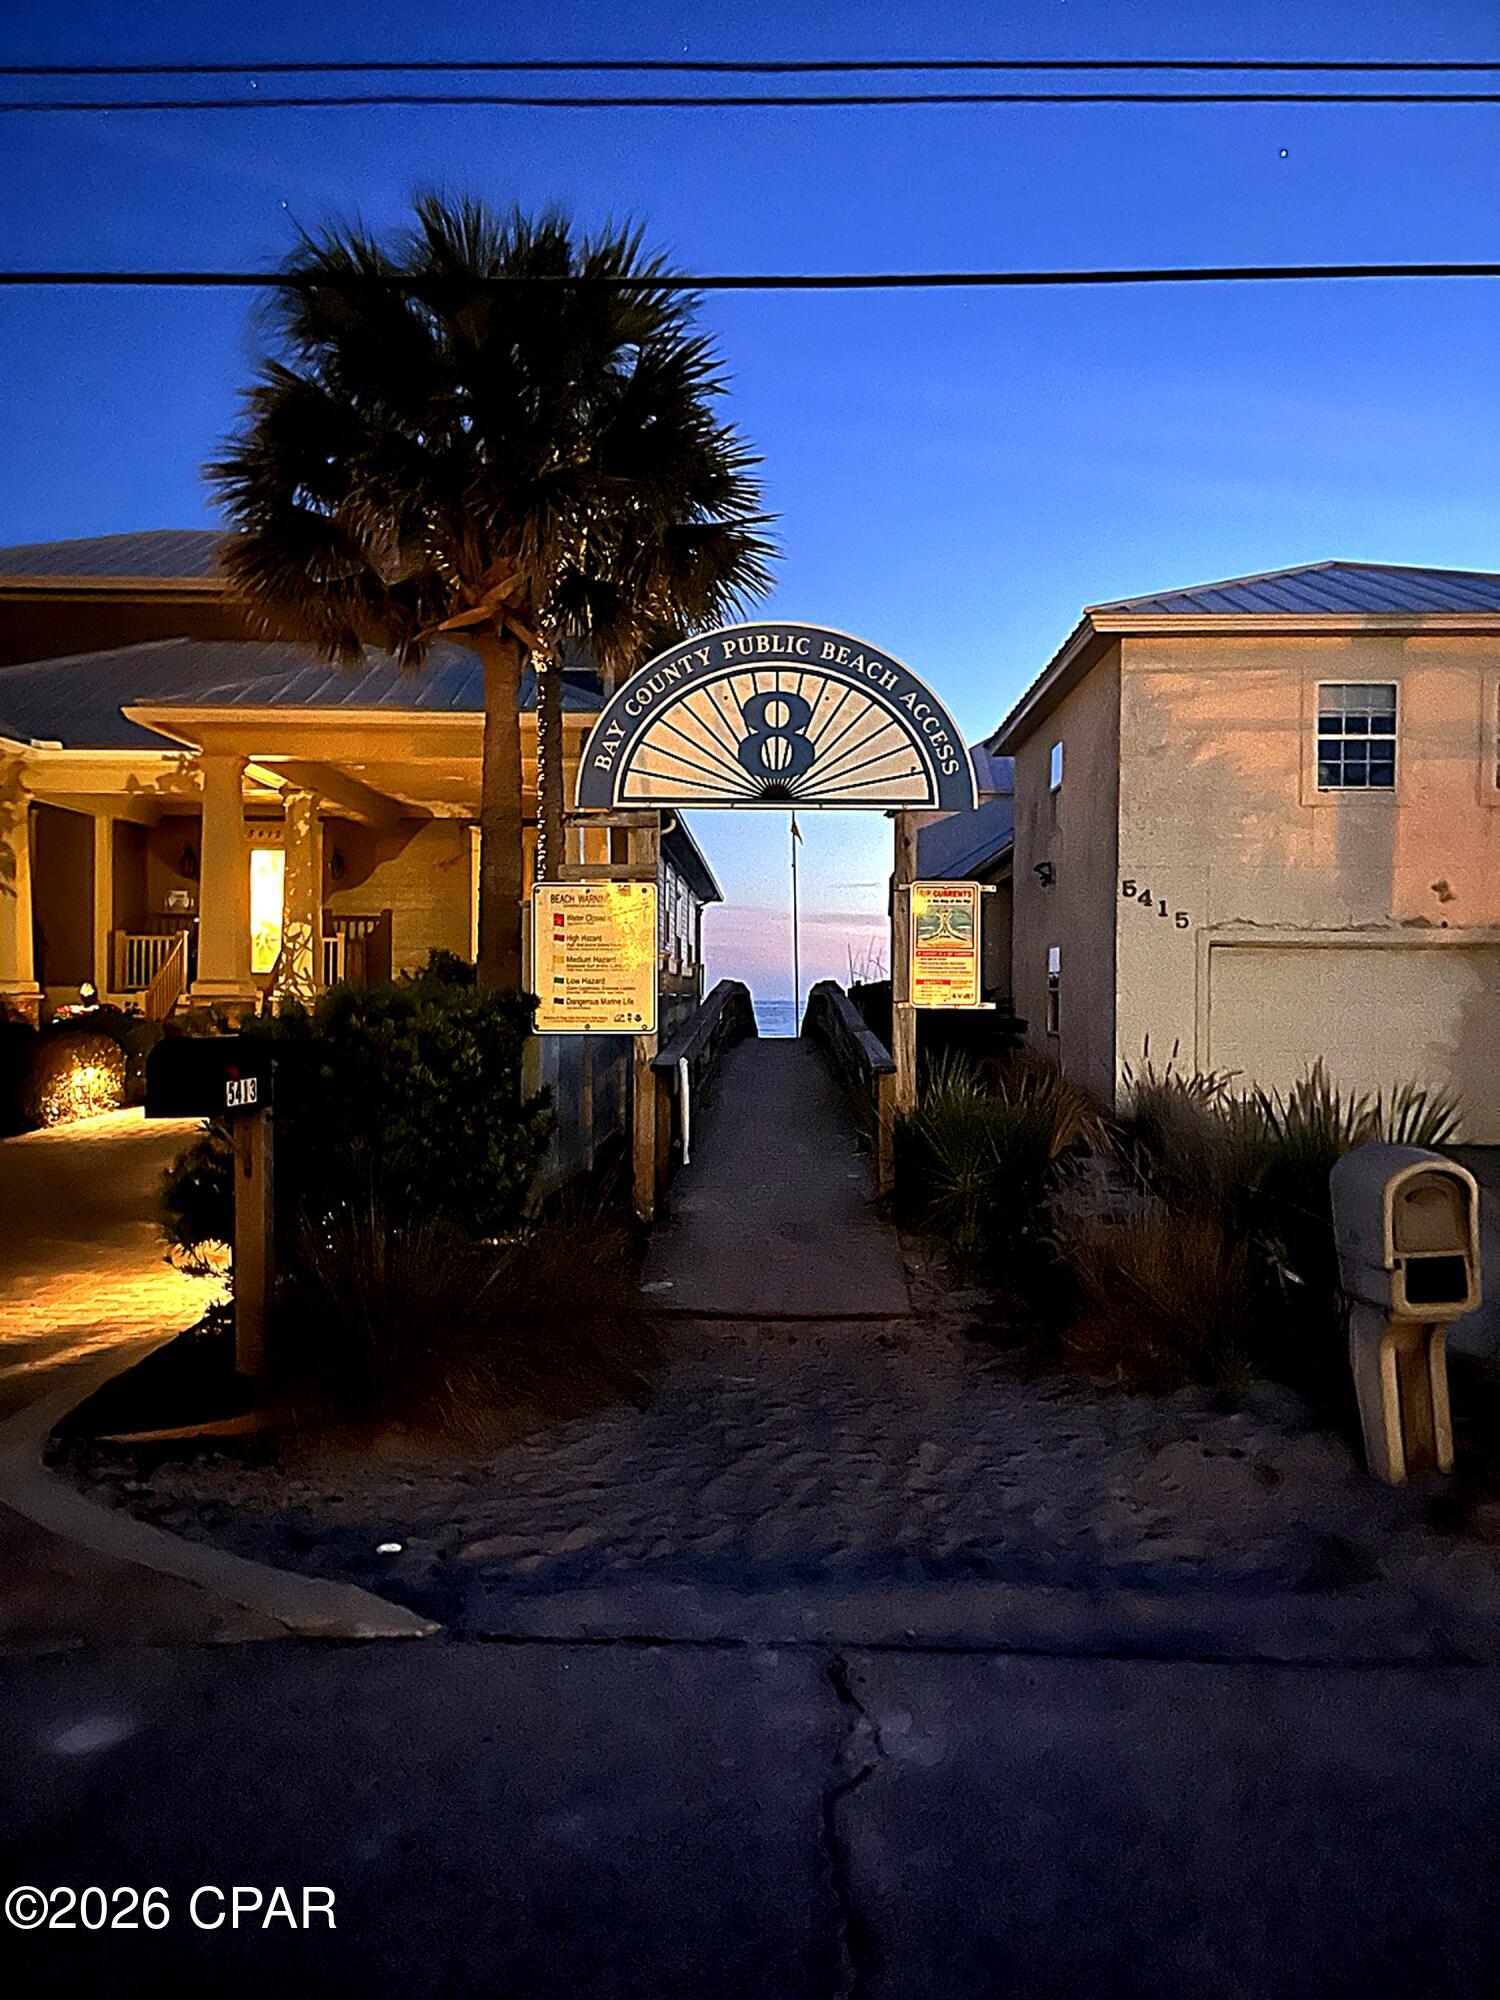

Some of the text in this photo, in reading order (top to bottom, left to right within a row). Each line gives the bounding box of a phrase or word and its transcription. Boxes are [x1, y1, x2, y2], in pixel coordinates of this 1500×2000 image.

[594, 634, 960, 776] BAY COUNTY PUBLIC BEACH ACCESS
[737, 690, 816, 780] 8
[550, 893, 609, 904] BEACH WARNI
[1122, 879, 1189, 929] 5415
[566, 977, 605, 985] Low Hazard
[228, 1080, 257, 1106] 5413
